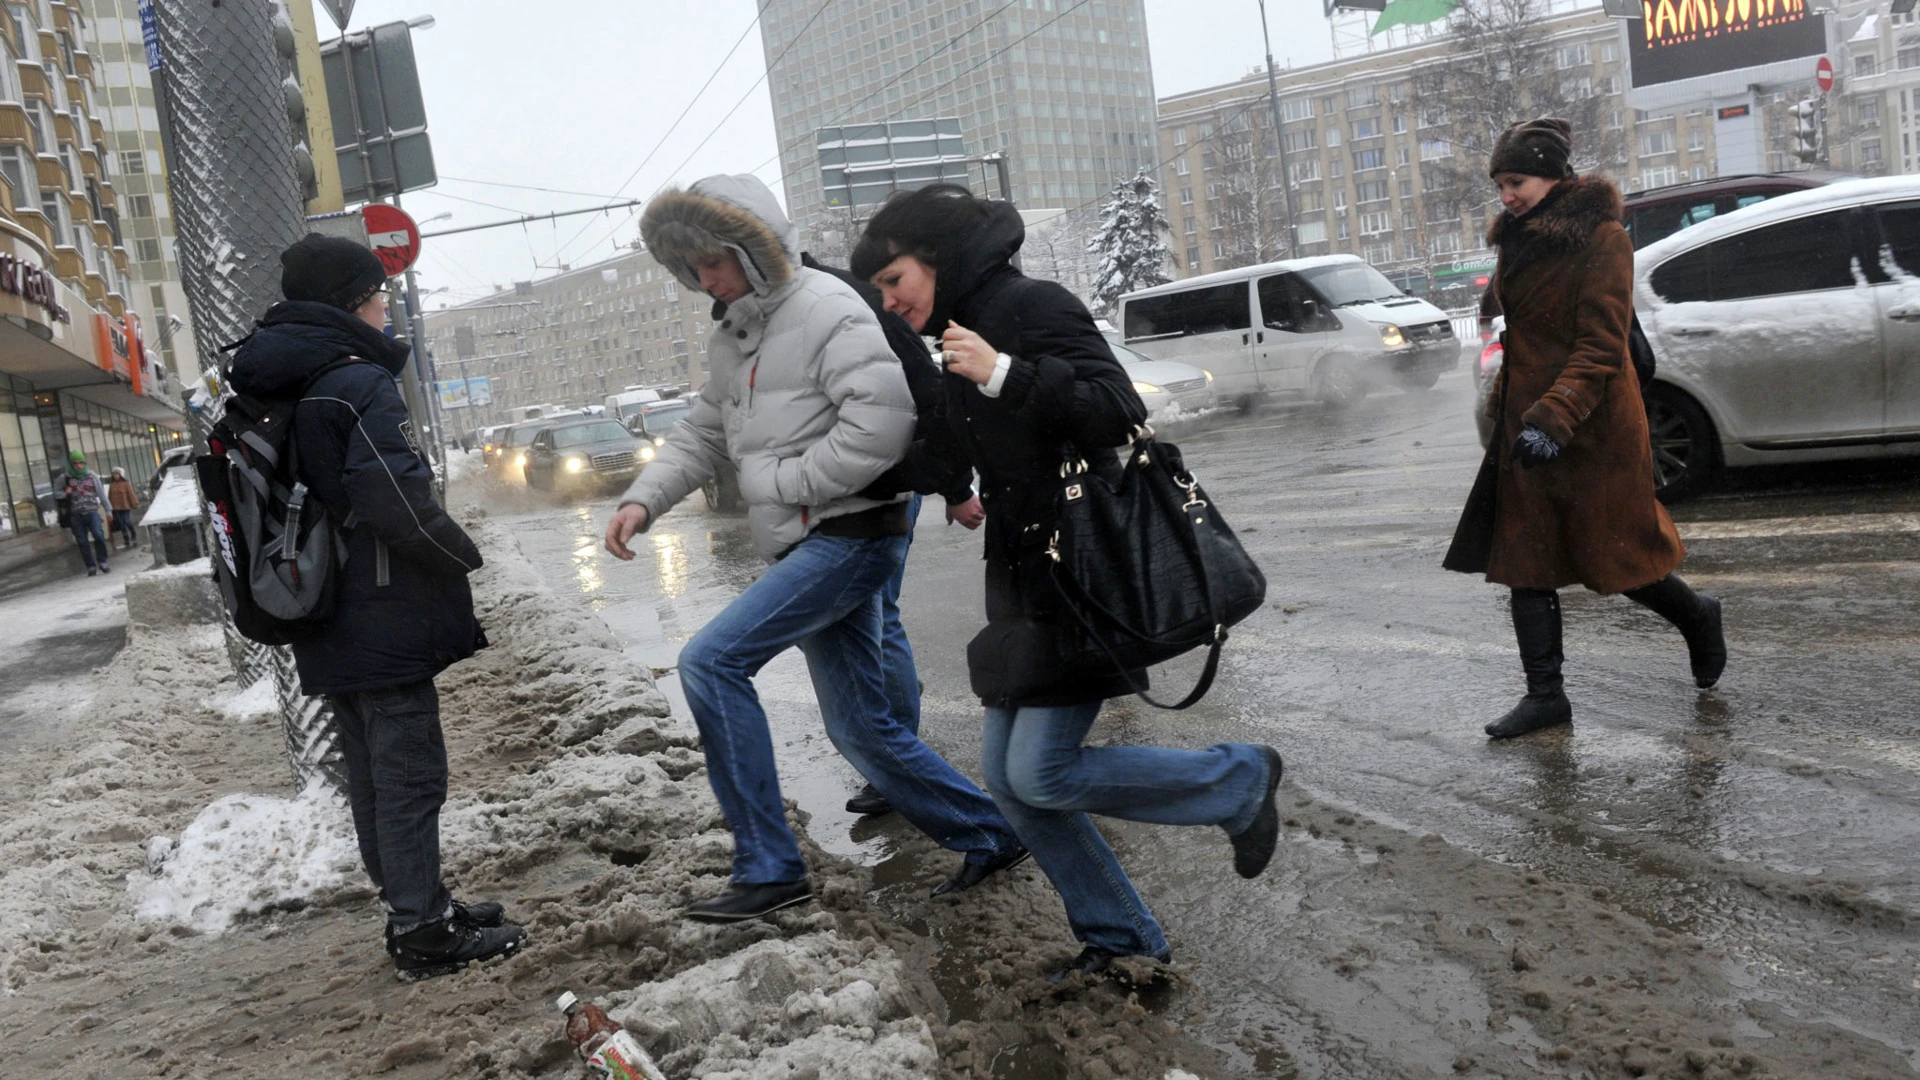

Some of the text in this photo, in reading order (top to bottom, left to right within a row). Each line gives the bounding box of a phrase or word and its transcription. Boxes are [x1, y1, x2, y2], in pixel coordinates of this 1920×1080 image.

[1661, 34, 1696, 46] TASTE
[1705, 29, 1719, 38] OF
[1727, 23, 1749, 33] THE
[1757, 12, 1804, 28] ORIENT
